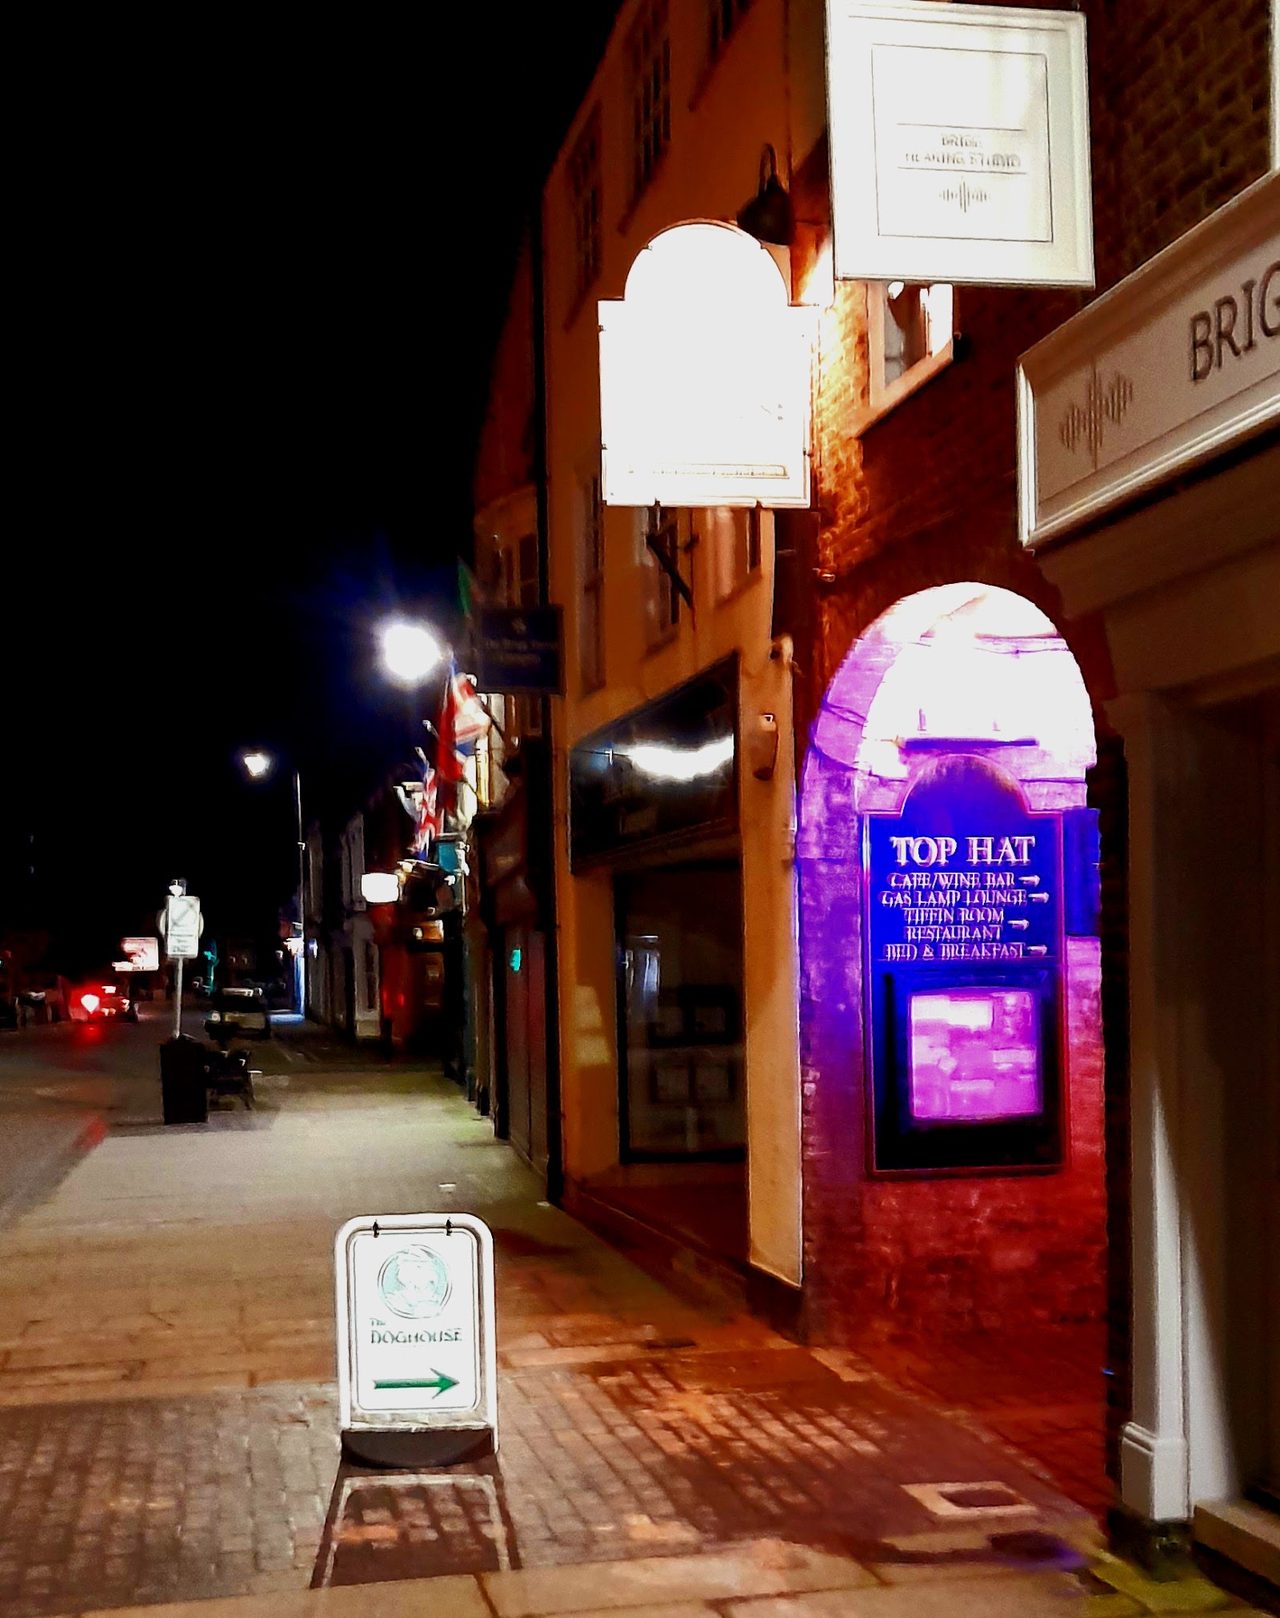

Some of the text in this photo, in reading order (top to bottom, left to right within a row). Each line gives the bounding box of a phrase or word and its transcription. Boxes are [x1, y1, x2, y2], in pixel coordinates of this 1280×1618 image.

[890, 835, 1036, 867] TOP HAT
[984, 872, 1015, 889] BAR
[881, 889, 1027, 907] GAS LAMP LOUNGE
[902, 907, 1005, 925] TIFFIN ROOM
[904, 925, 1003, 943] RESTAURANT
[884, 942, 1026, 961] BED & BREAKFAST
[370, 1328, 463, 1344] DOGHOUSE
